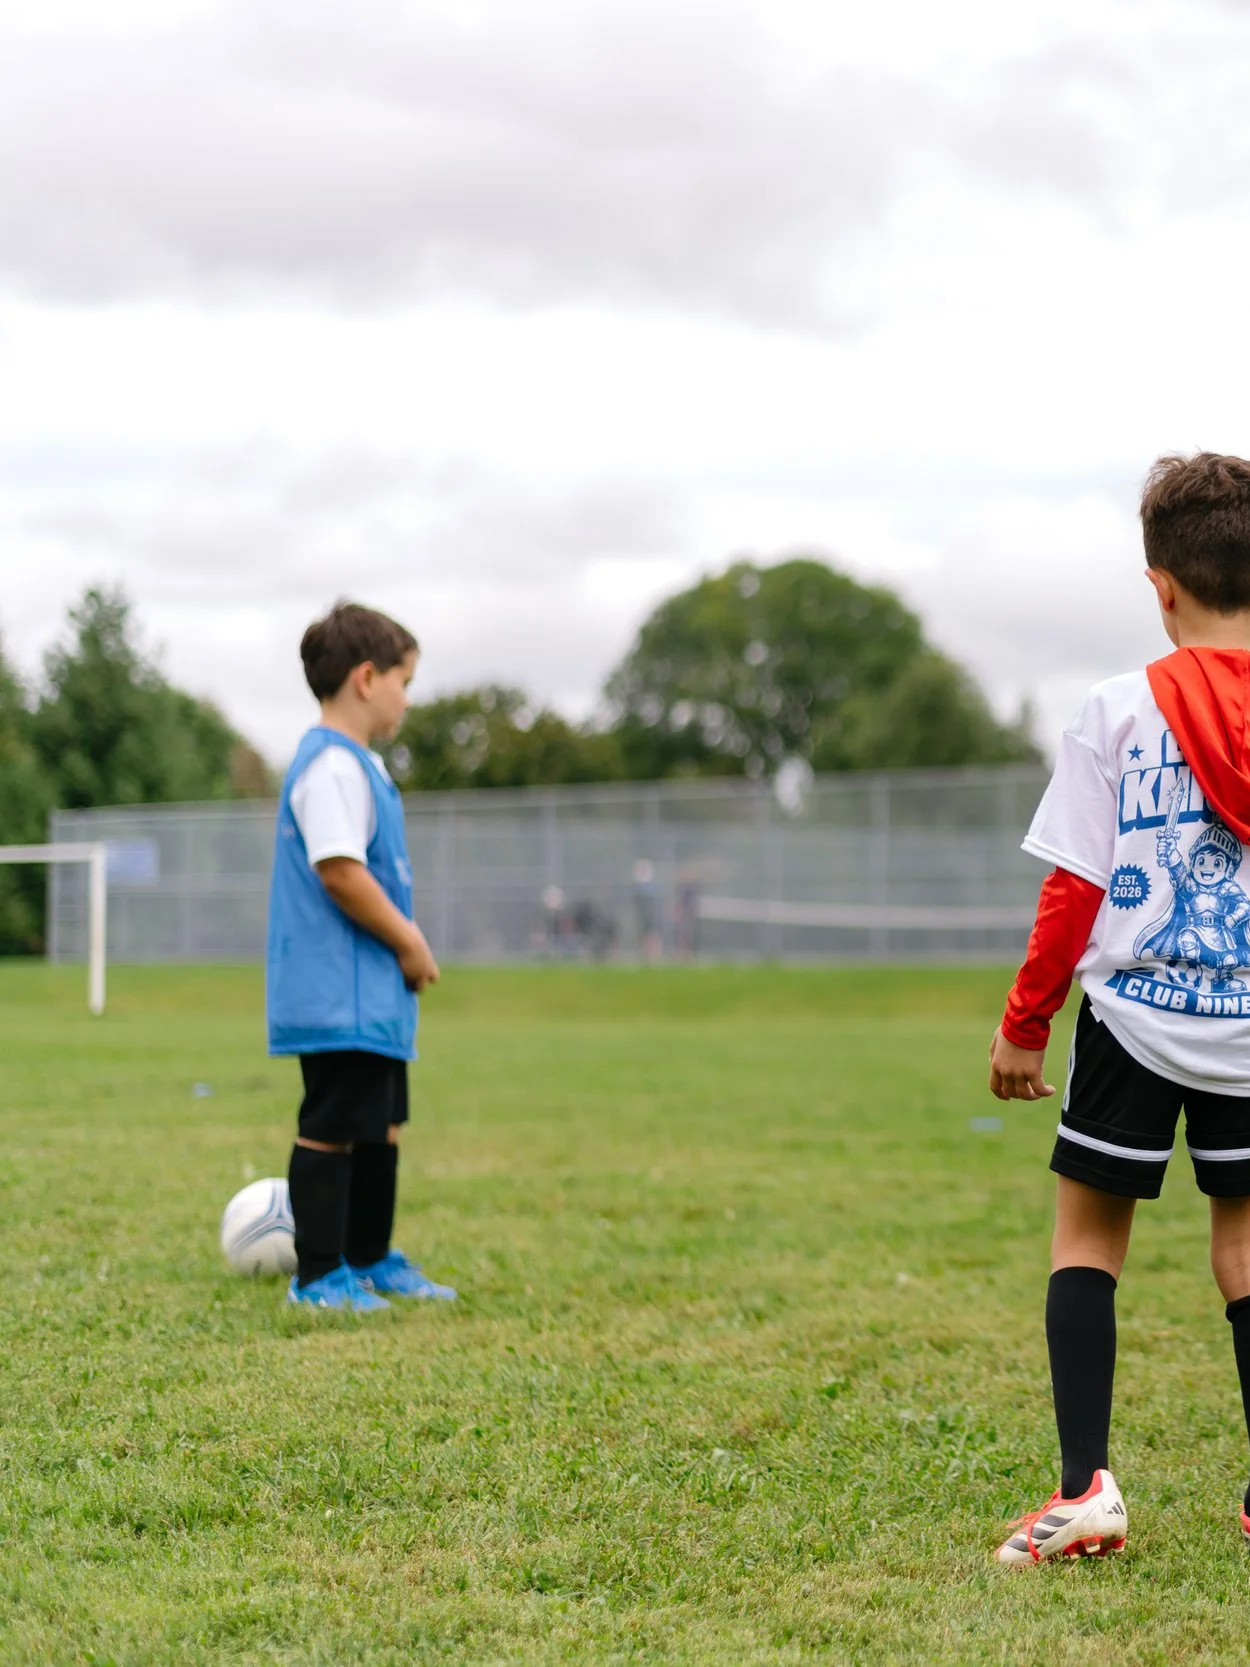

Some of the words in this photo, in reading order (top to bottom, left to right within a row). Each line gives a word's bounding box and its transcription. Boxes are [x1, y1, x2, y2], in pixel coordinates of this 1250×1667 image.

[1117, 874, 1139, 886] EST.
[1112, 886, 1142, 898] 2026
[1124, 977, 1188, 1010] CLUB
